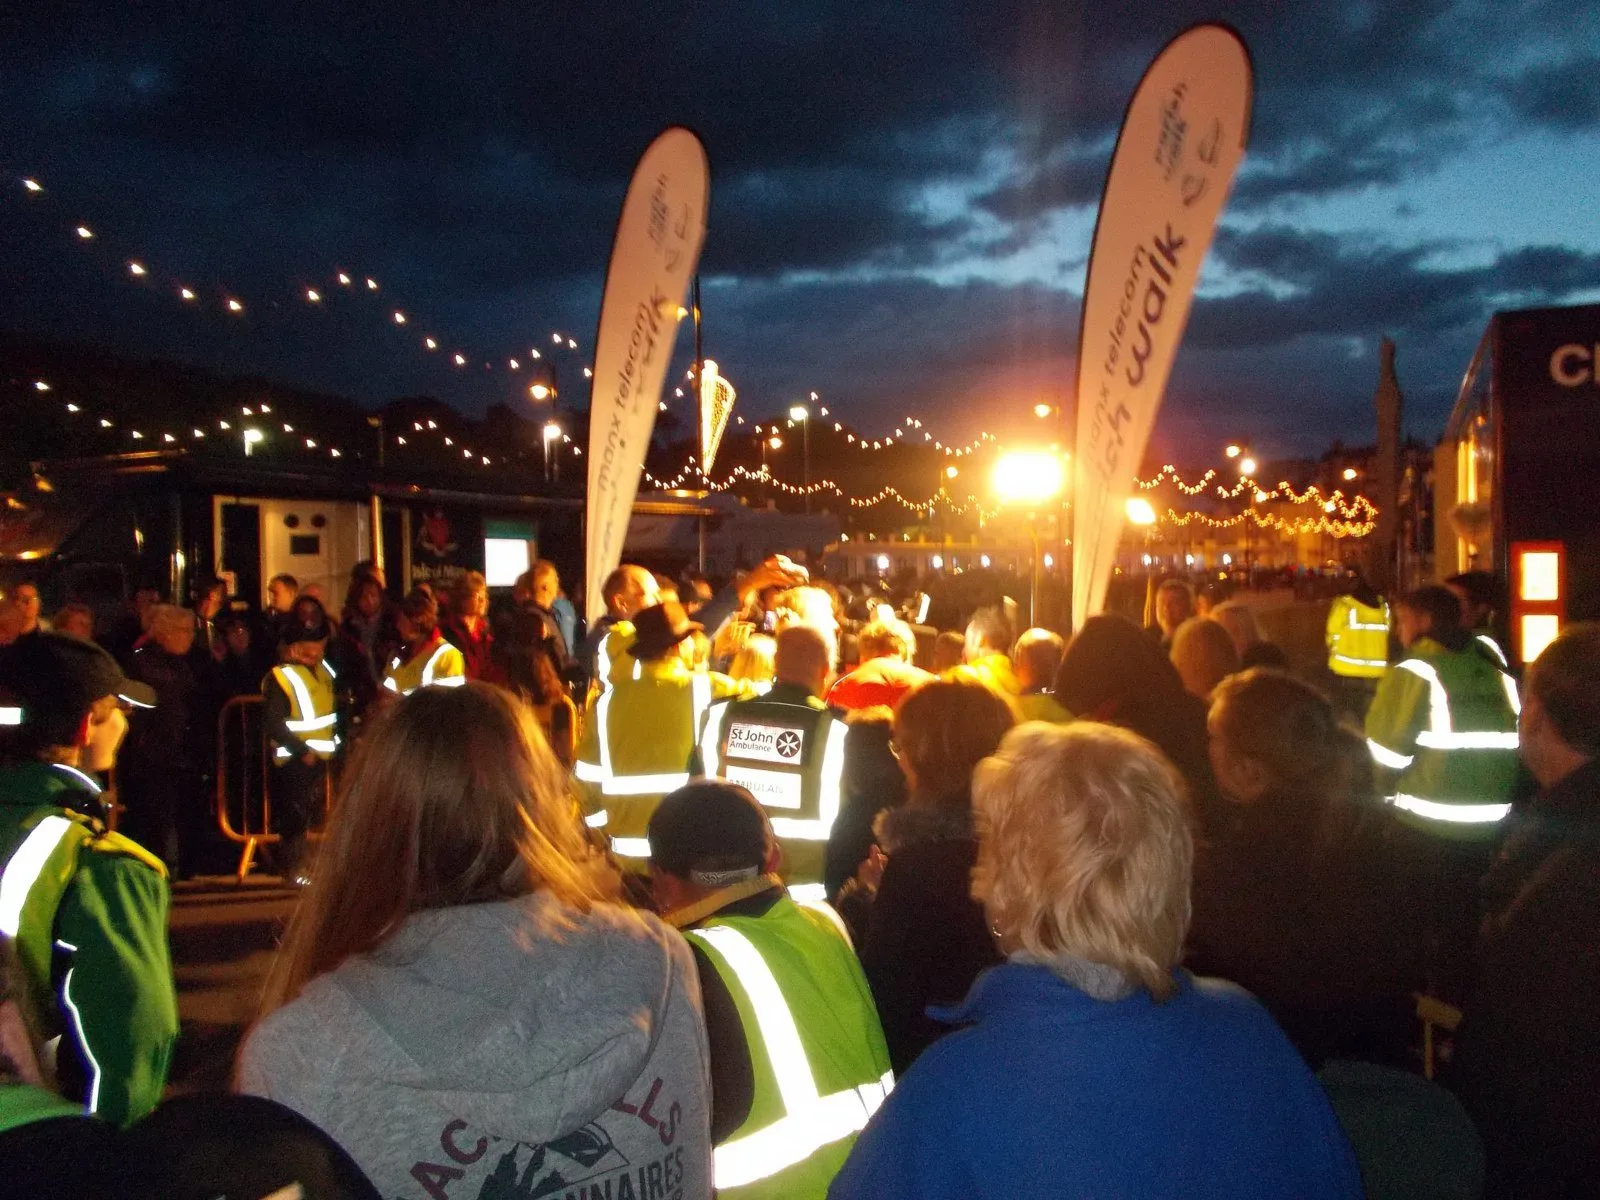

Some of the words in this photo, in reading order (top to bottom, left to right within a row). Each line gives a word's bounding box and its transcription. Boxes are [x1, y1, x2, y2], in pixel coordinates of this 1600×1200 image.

[1104, 243, 1146, 377] telecom
[1126, 222, 1187, 387] walk
[598, 412, 621, 492] manx
[614, 301, 650, 409] telecom
[729, 741, 772, 753] Ambulance
[731, 728, 742, 740] St
[745, 730, 773, 744] John
